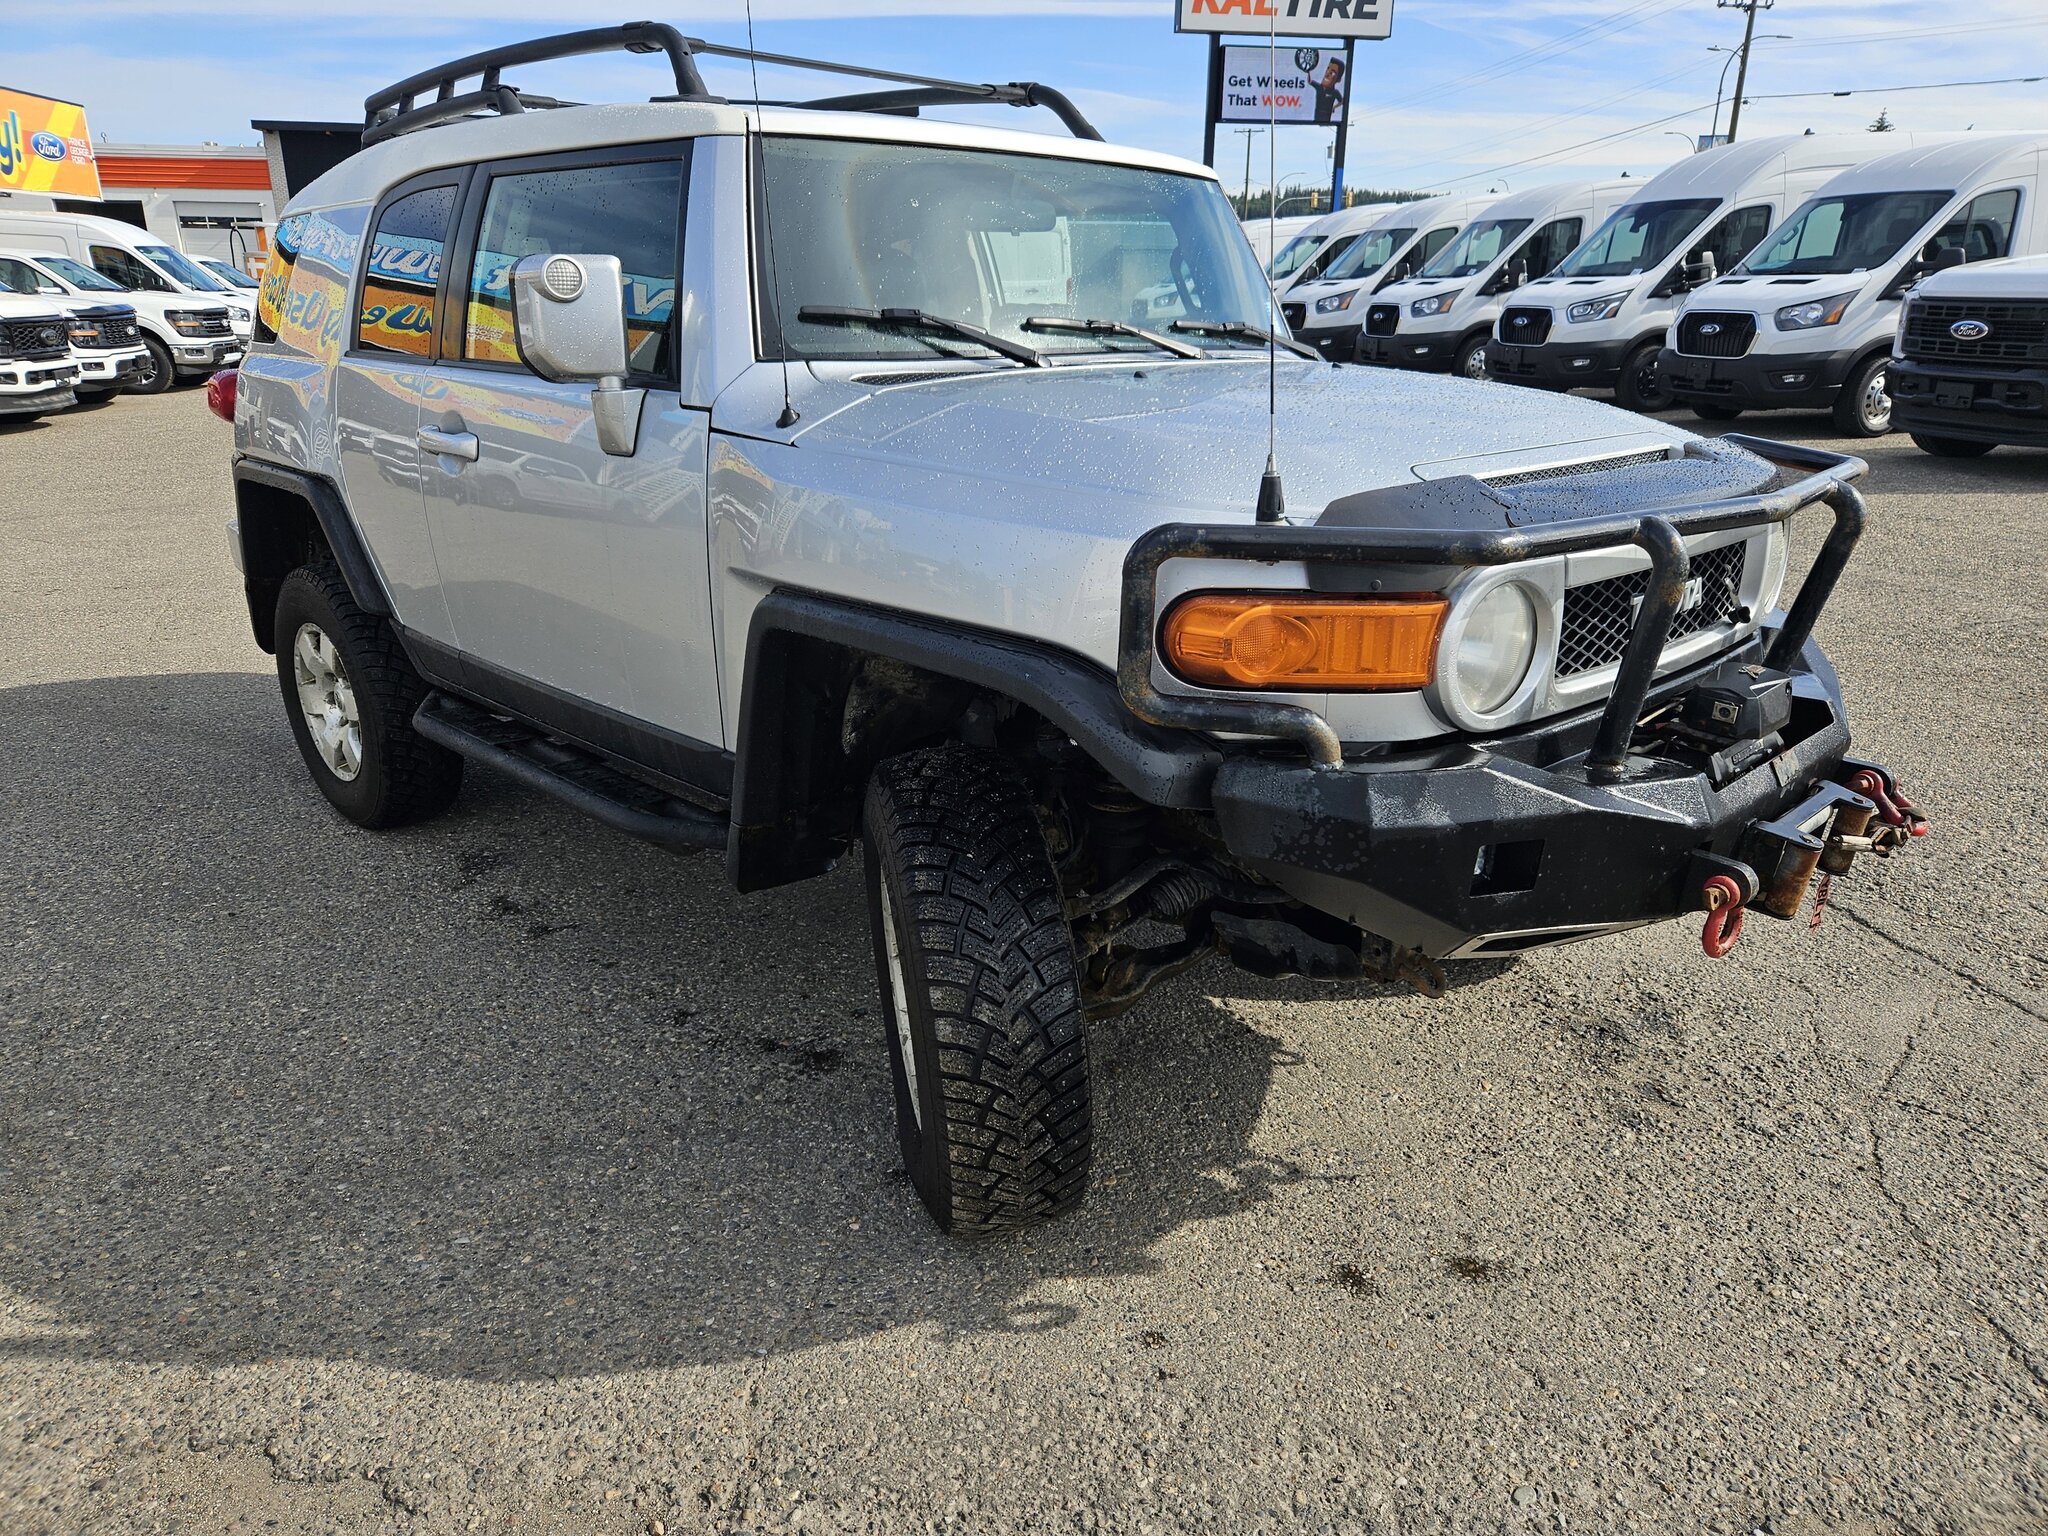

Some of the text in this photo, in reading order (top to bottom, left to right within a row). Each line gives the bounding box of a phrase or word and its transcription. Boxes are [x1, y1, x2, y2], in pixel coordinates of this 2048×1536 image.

[1228, 75, 1253, 88] Get
[1227, 94, 1258, 106] That
[38, 134, 61, 158] Ford
[1957, 324, 1979, 337] Ford
